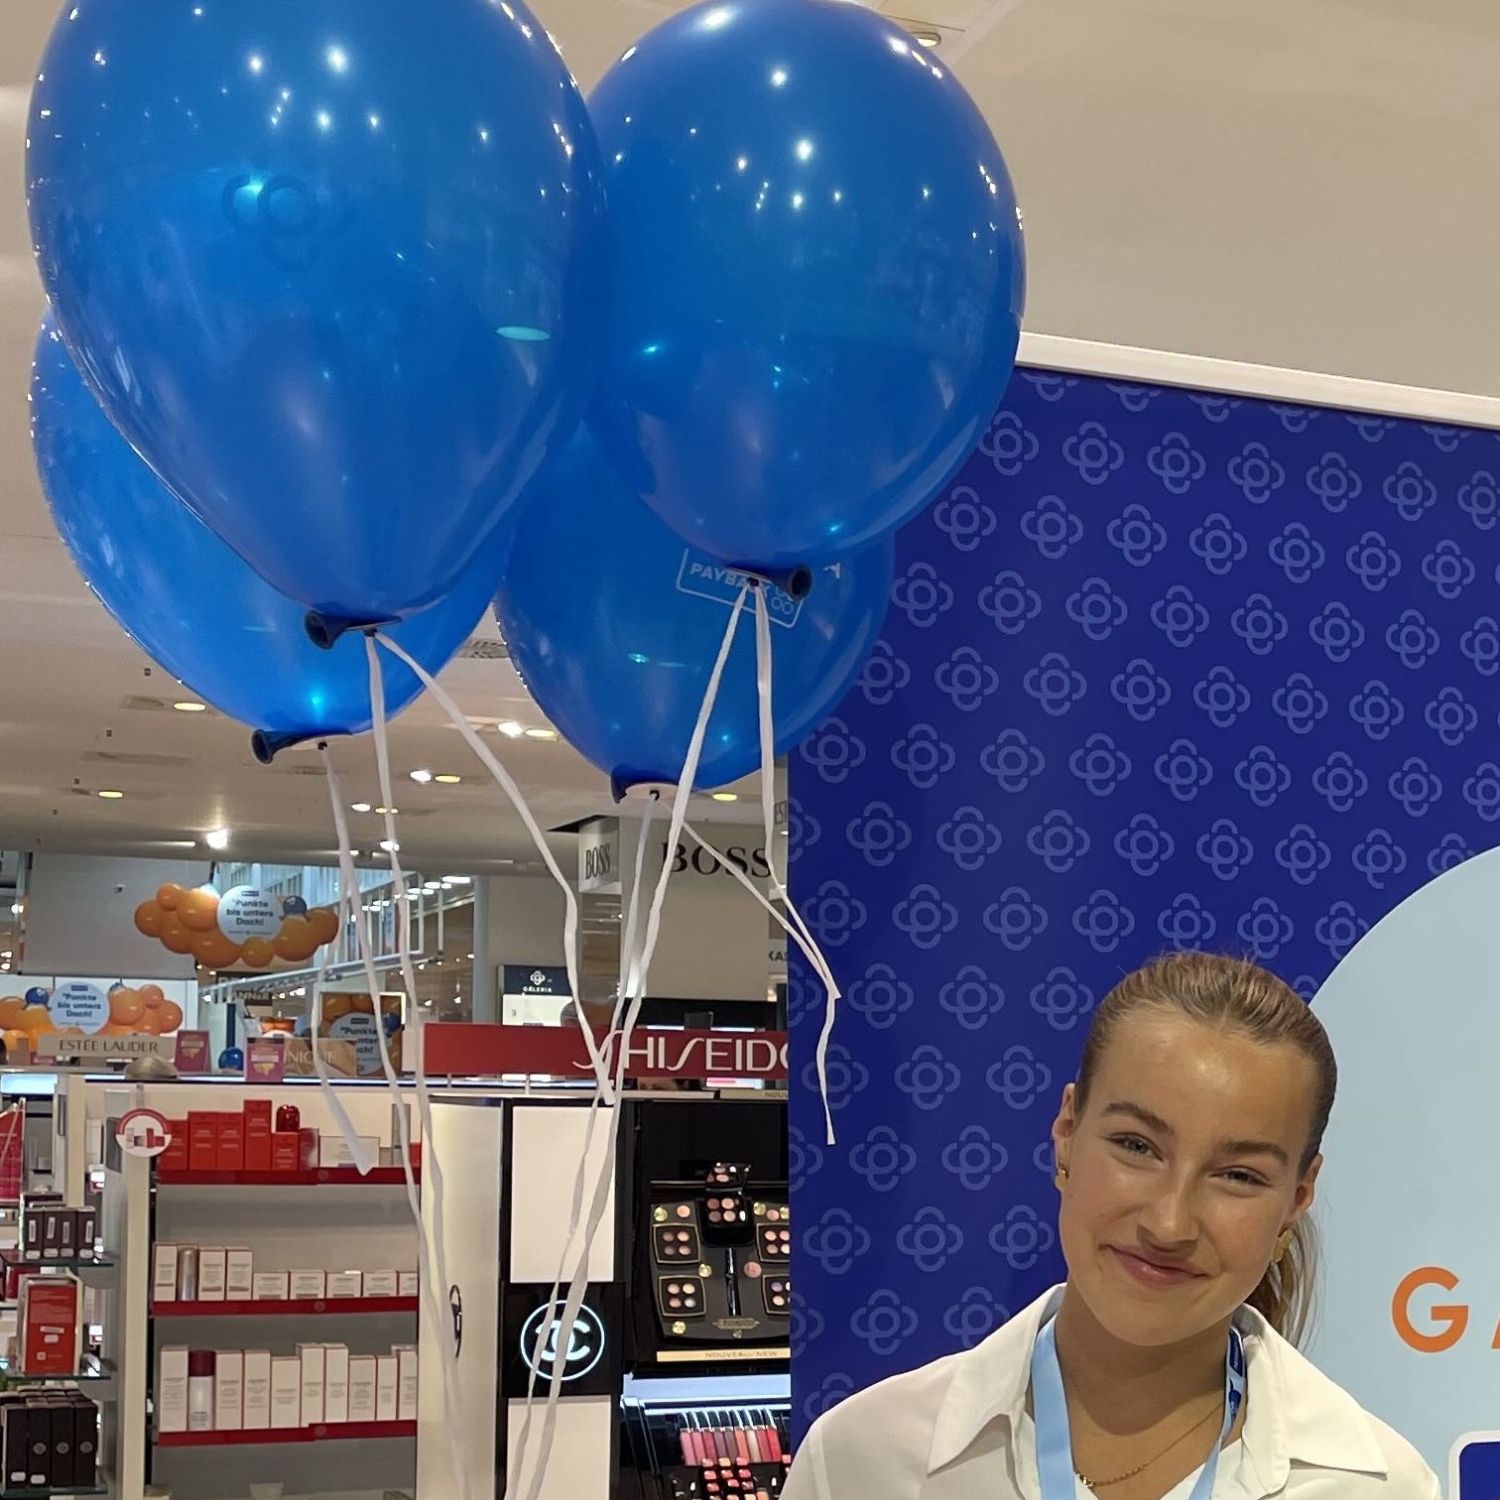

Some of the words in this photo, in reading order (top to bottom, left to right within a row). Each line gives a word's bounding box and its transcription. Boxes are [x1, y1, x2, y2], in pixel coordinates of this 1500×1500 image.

[585, 843, 611, 880] BOSS
[661, 841, 771, 878] BOSS
[59, 1038, 98, 1052] ESTÉE
[103, 1039, 159, 1053] LAUDER
